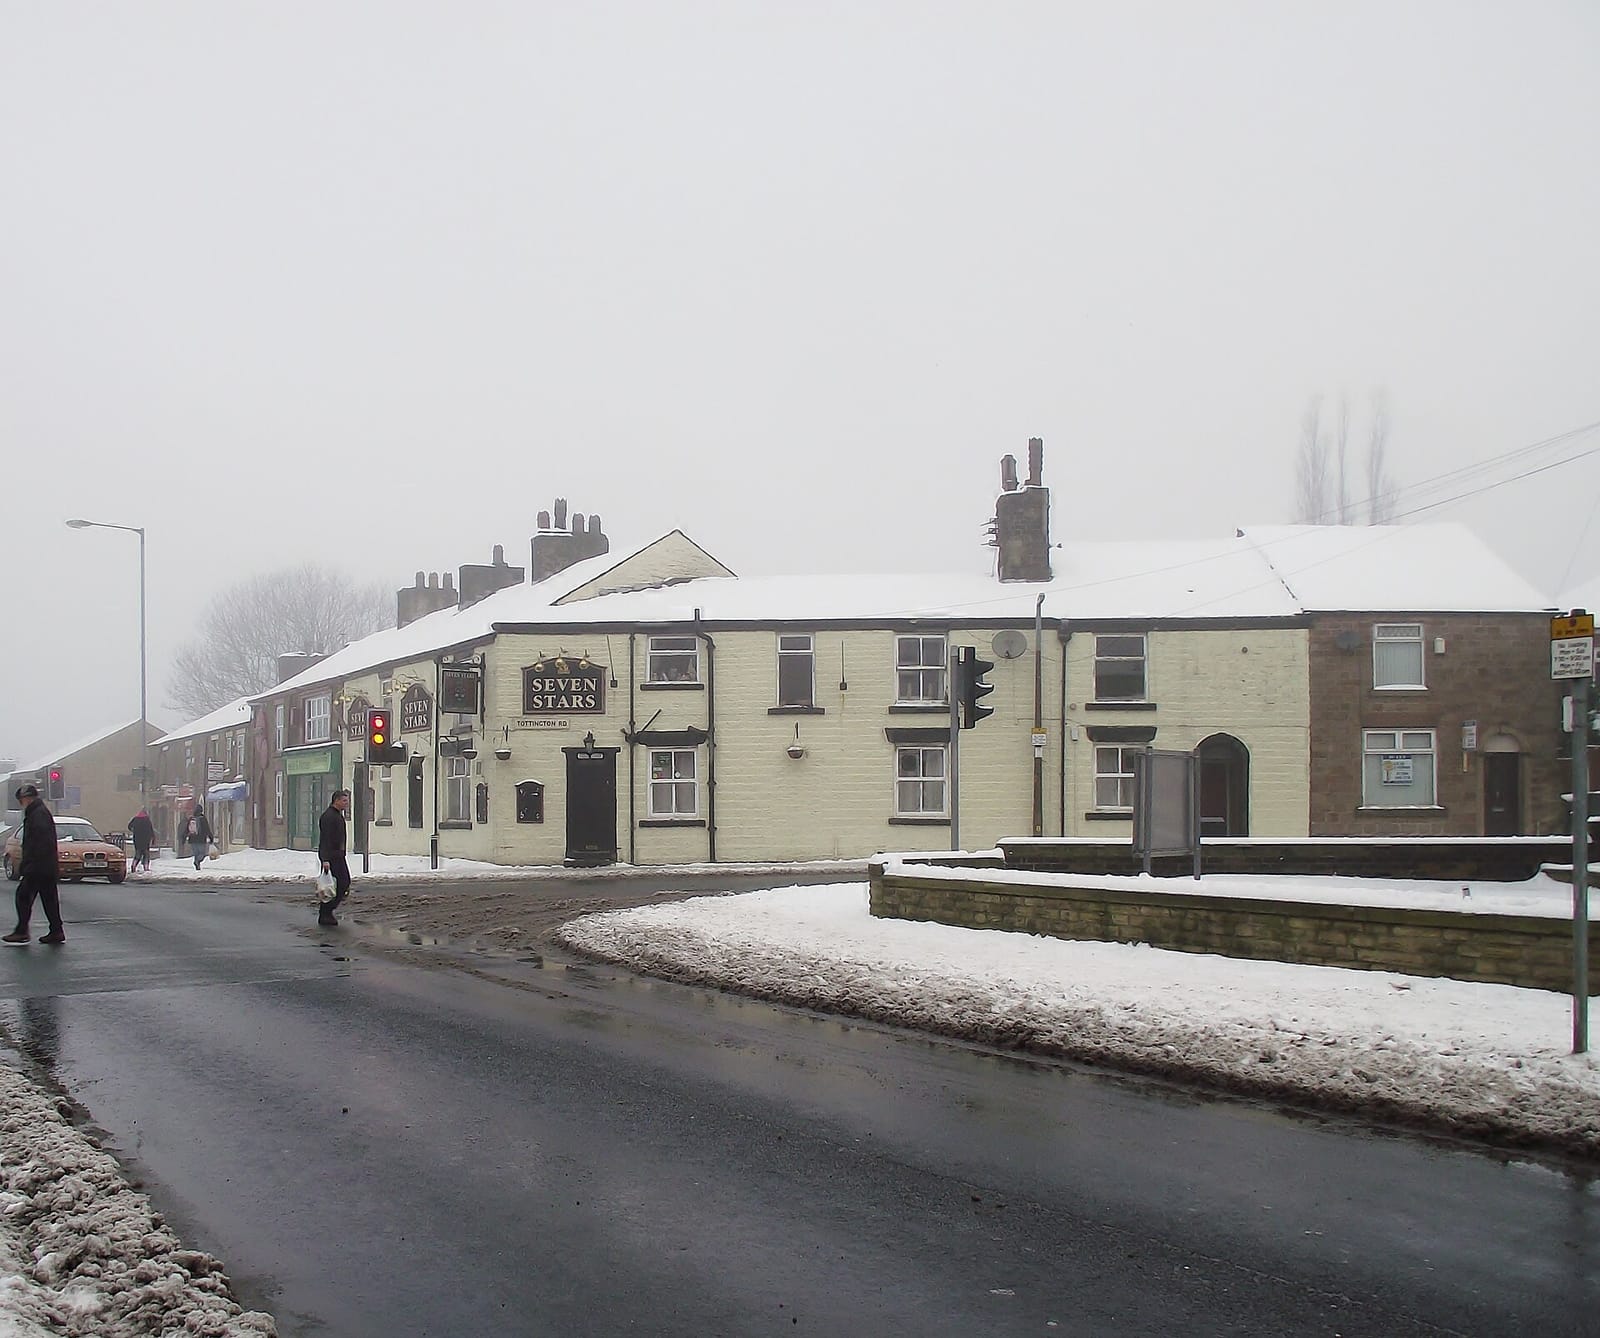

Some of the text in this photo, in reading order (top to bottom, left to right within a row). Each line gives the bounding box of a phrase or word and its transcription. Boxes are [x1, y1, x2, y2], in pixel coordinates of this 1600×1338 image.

[532, 678, 598, 692] SEVEN
[404, 699, 429, 714] SEVEN
[532, 694, 596, 709] STARS
[404, 714, 427, 729] STARS
